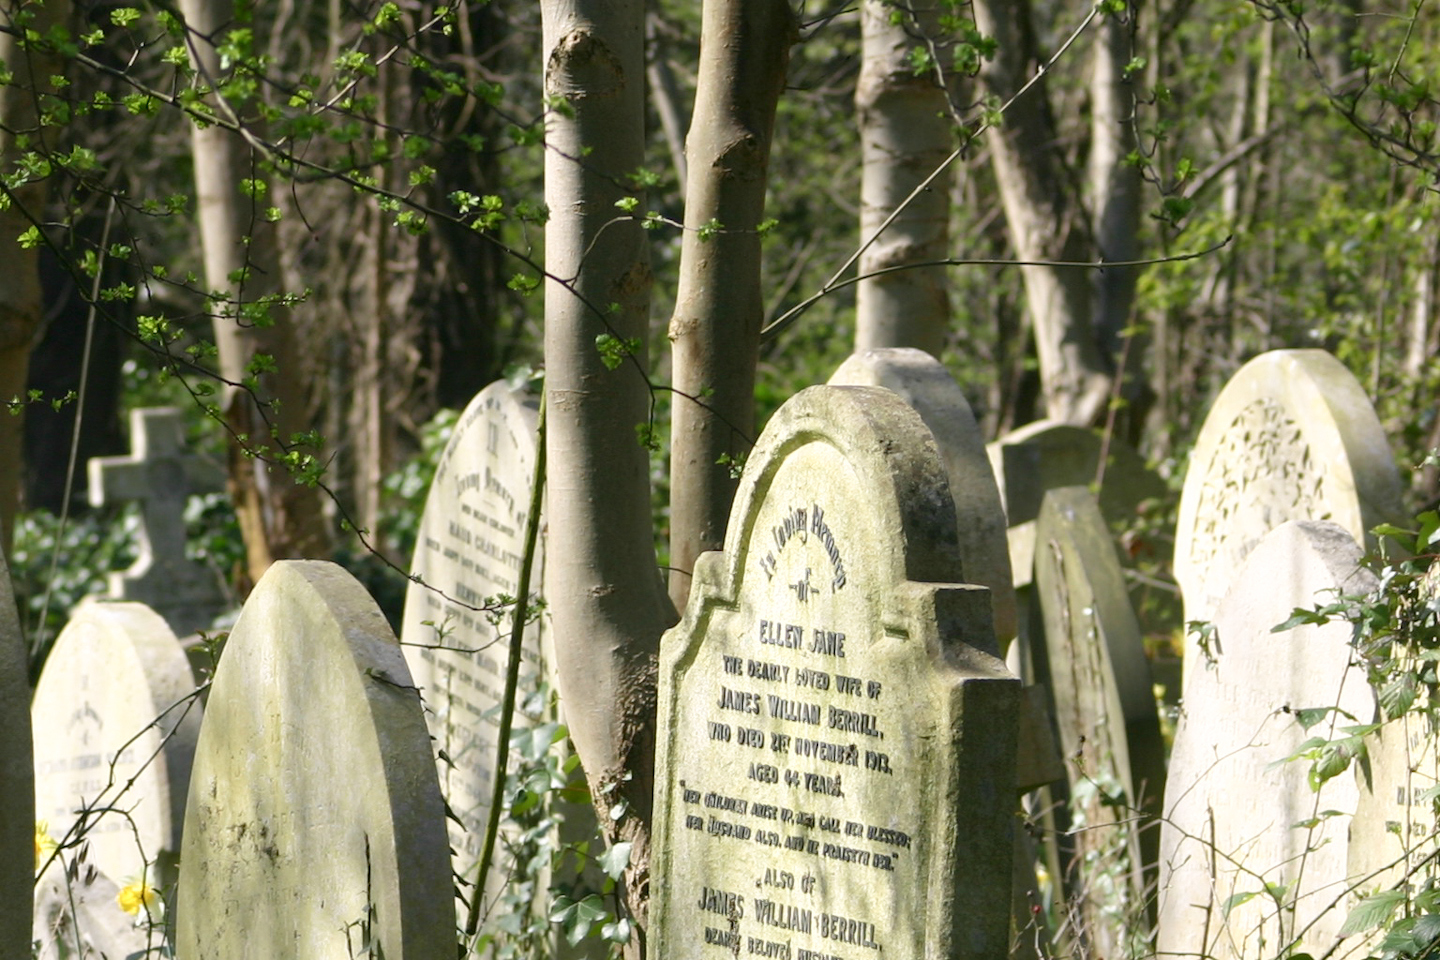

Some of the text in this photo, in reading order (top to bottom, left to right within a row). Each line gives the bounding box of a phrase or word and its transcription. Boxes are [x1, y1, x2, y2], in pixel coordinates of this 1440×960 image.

[760, 619, 846, 658] ELLEN JANE
[722, 654, 882, 700] THE DEARLY LOVED WIFE OF
[717, 686, 761, 715] JAMES
[766, 693, 822, 726] WILLIAM
[707, 721, 731, 743] WHO
[737, 726, 764, 749] DIED
[795, 737, 859, 768] NOVEMBER
[748, 762, 779, 784] AGED
[686, 815, 703, 832] HER
[819, 815, 841, 833] CALL
[845, 821, 864, 838] HER
[764, 867, 816, 895] ALSO OF
[698, 886, 745, 919] JAMES
[754, 897, 812, 935] WILLIAM
